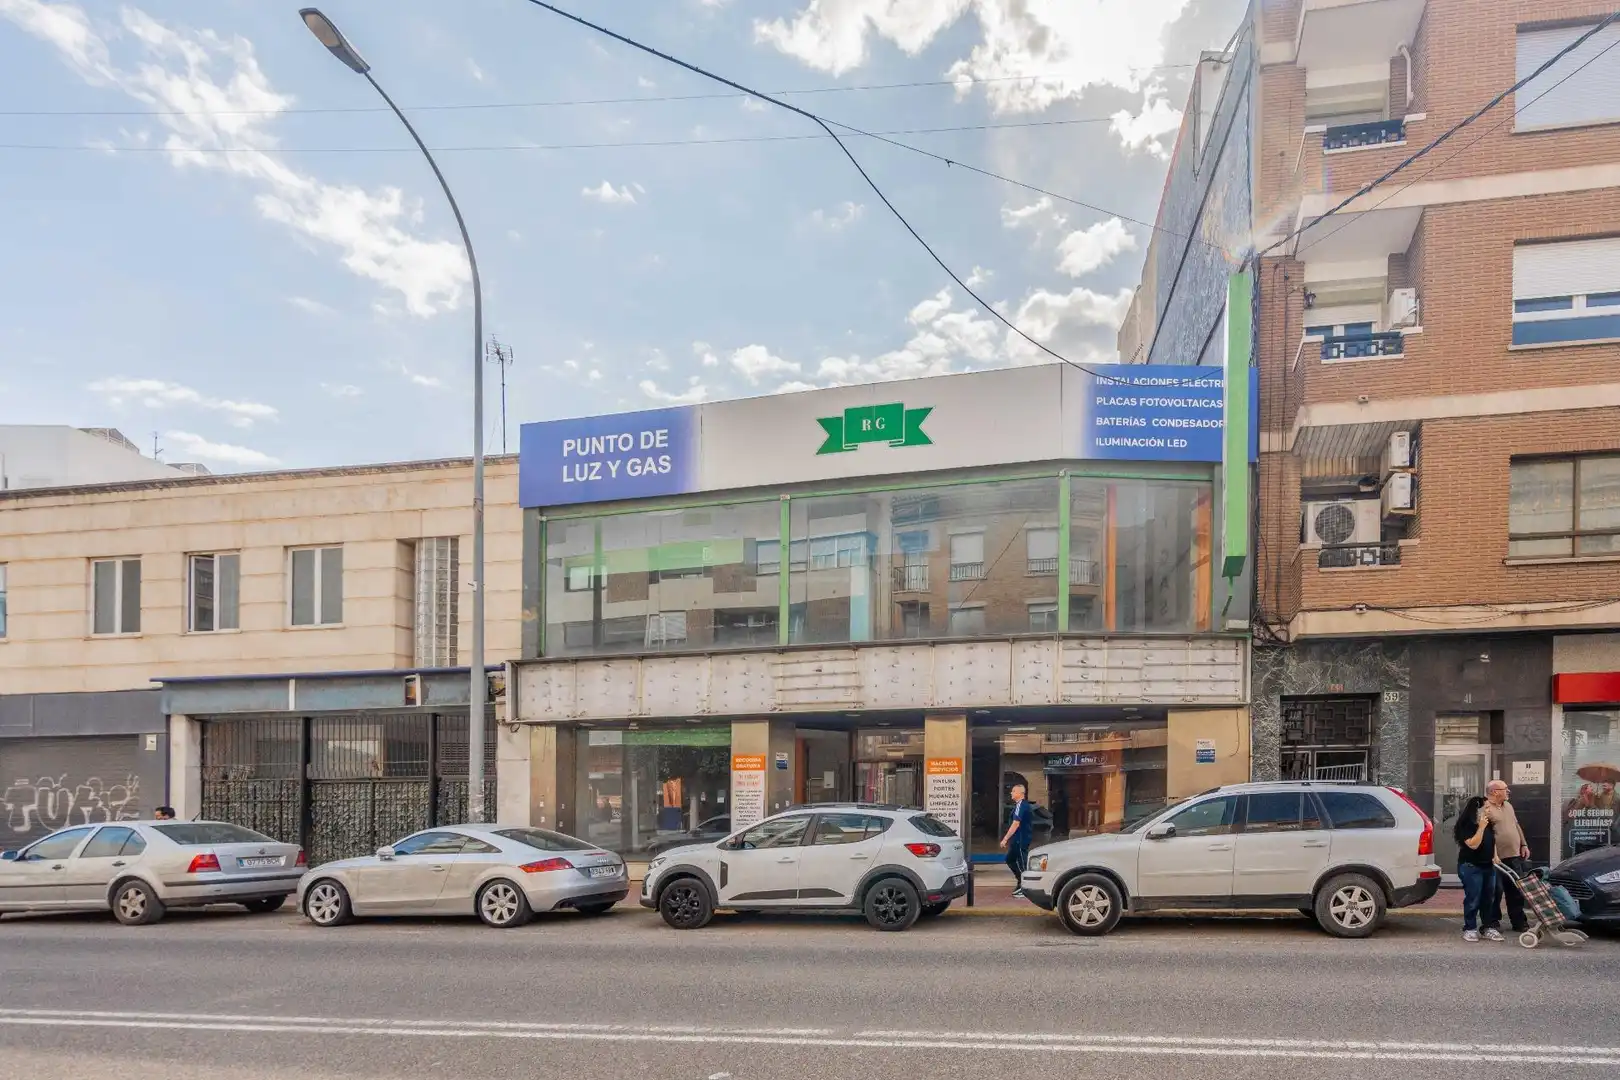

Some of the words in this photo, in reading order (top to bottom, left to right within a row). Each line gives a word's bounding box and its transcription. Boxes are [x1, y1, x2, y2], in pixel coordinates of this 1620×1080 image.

[1096, 376, 1180, 387] INSTALACIONES
[1096, 397, 1137, 406] PLACAS
[1139, 398, 1223, 408] FOTOVOLTAICAS
[1096, 416, 1147, 427] BATERÍAS
[563, 433, 634, 457] PUNTO
[640, 429, 668, 449] DE
[1096, 436, 1165, 447] ILUMINACIÓN
[1167, 438, 1188, 448] LED
[562, 462, 602, 483] LUZ
[607, 459, 622, 478] Y
[626, 455, 672, 477] GAS
[1385, 692, 1398, 701] 39
[1568, 807, 1586, 818] ¿QUÉ
[1587, 808, 1614, 817] SEGURO
[1574, 817, 1613, 827] ELEGIRÍAS?
